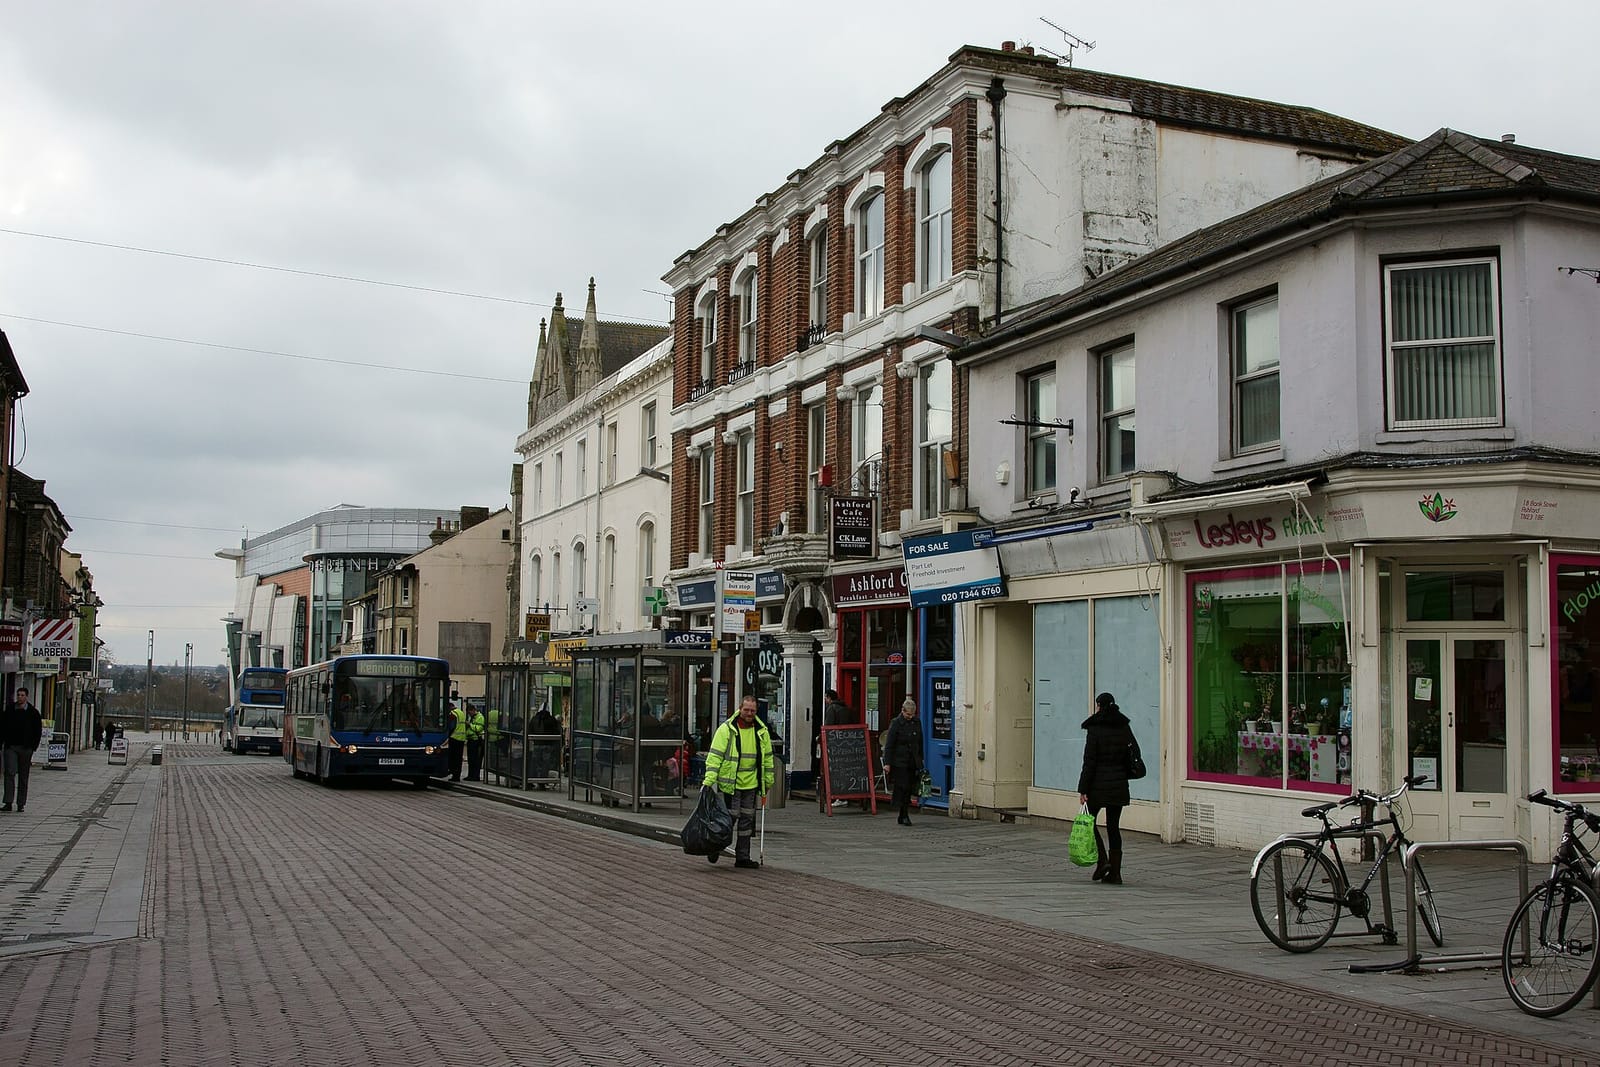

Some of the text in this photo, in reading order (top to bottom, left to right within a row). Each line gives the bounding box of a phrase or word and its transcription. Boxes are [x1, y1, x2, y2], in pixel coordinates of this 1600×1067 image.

[835, 500, 871, 508] Ashford
[842, 508, 863, 516] Cafe
[1193, 512, 1277, 549] Lesleys
[851, 534, 867, 542] Law
[908, 541, 949, 555] FOR SALE
[912, 565, 965, 578] Freehold Investment
[850, 572, 894, 592] Ashford
[941, 592, 958, 602] 020
[959, 589, 979, 599] 7344
[981, 586, 1001, 596] 6760
[33, 647, 72, 657] BARBERS
[360, 662, 428, 675] Kennington C
